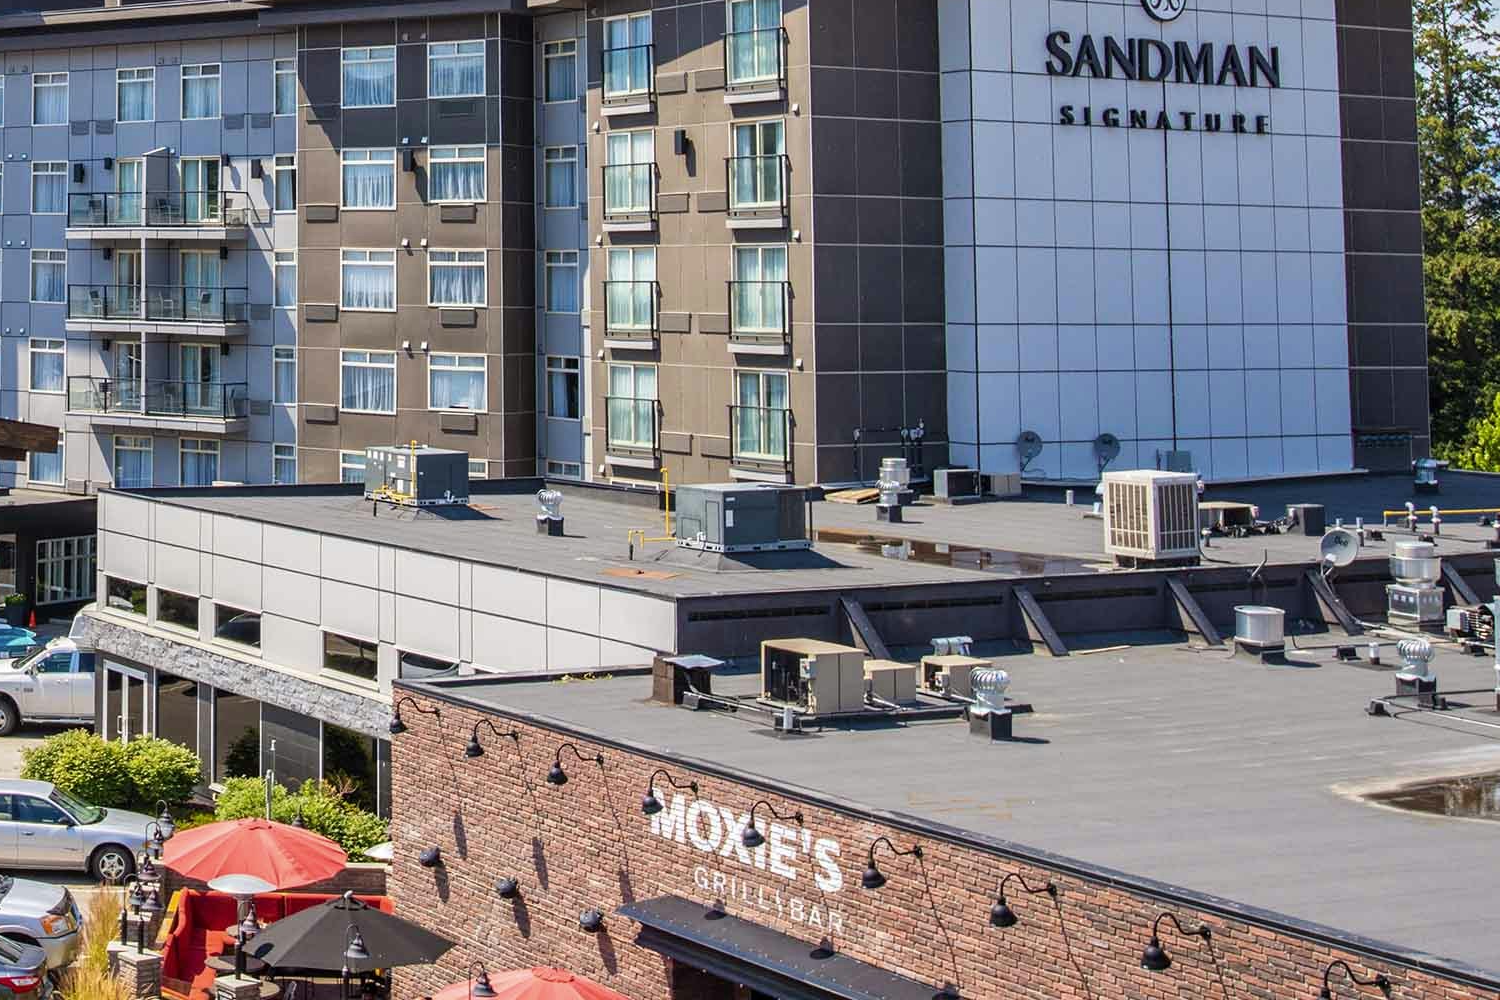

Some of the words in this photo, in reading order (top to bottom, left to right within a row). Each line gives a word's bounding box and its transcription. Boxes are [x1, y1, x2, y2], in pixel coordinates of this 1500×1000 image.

[1045, 30, 1281, 89] SANDMAN
[1059, 104, 1270, 135] SIGNATURE
[650, 786, 844, 892] MOXIE'S
[694, 866, 771, 911] GRILL
[789, 896, 843, 936] BAR
